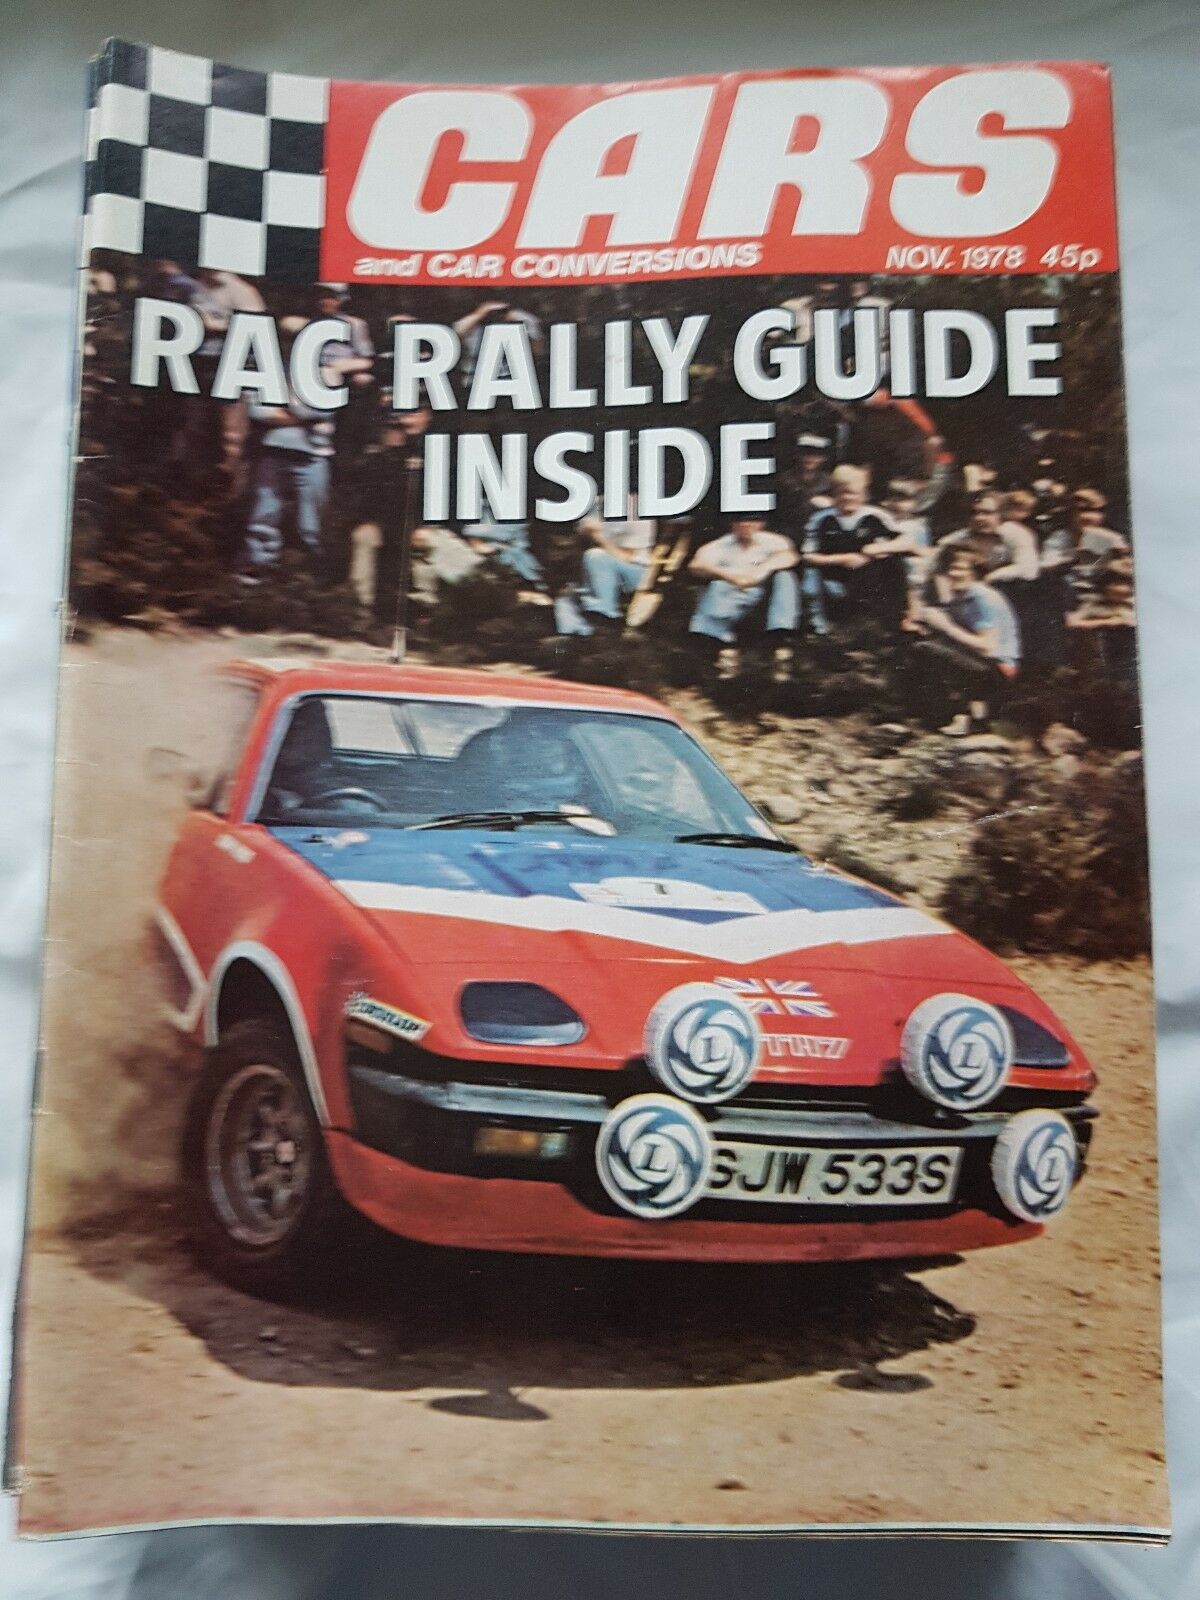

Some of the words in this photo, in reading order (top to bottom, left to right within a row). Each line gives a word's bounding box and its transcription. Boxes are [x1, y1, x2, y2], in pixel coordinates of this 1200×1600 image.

[346, 69, 1072, 250] CARS
[353, 253, 422, 278] and
[426, 253, 505, 279] CAR
[510, 242, 764, 279] CONVERSIONS
[884, 245, 954, 270] NOV.
[960, 245, 1025, 270] 1978
[1039, 243, 1102, 272] 45p
[130, 297, 350, 410] RAC
[393, 314, 708, 412] RALLY
[734, 307, 1062, 400] GUIDE
[423, 421, 777, 523] INSIDE
[820, 1153, 950, 1195] 533S
